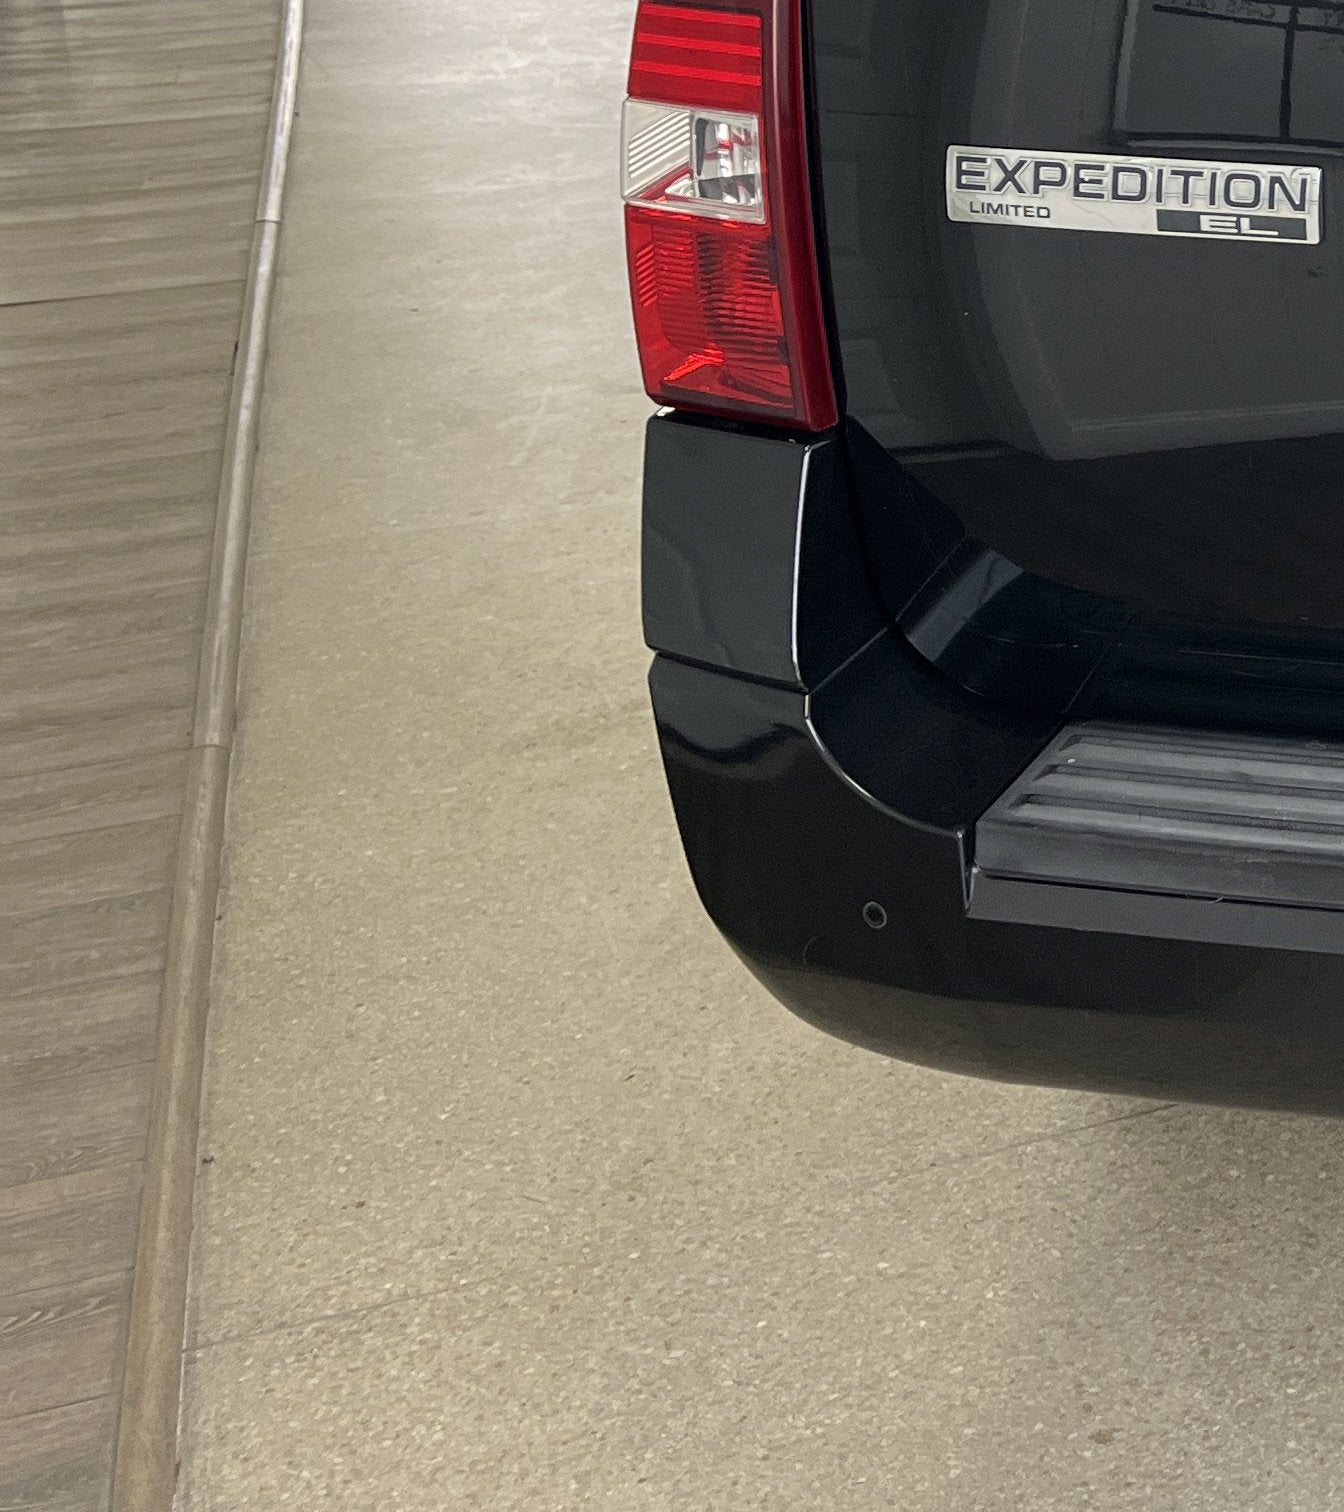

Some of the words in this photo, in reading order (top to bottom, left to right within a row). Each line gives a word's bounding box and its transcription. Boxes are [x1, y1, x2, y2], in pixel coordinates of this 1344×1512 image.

[954, 155, 1309, 212] EXPEDITION
[969, 200, 1051, 219] LIMITED
[1200, 215, 1280, 236] EL
